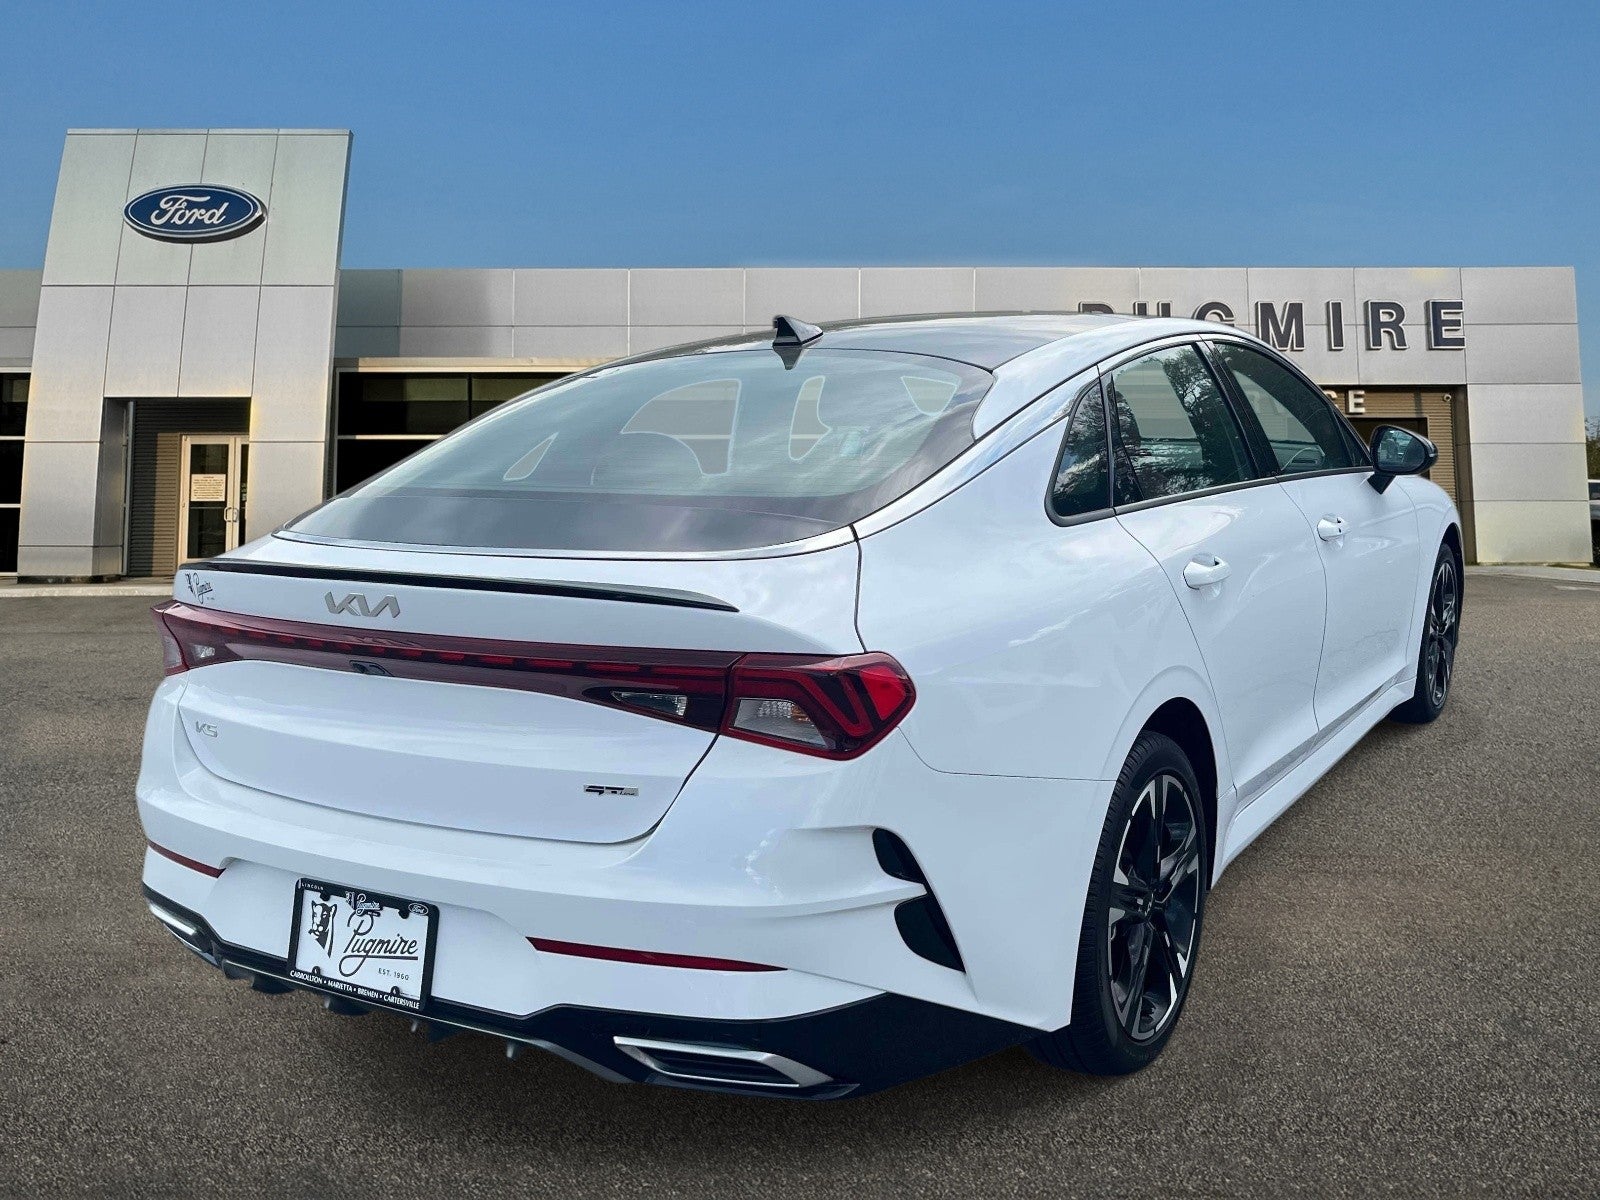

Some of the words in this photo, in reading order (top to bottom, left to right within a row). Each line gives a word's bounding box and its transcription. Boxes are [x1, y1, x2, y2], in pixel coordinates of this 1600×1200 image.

[150, 195, 230, 225] Ford
[1078, 300, 1466, 350] MIRE
[324, 591, 400, 618] KIA
[301, 882, 324, 891] LINCOLN
[338, 911, 419, 978] Pugmire
[378, 967, 392, 977] EST.
[394, 971, 410, 981] 1960
[289, 969, 324, 985] CARROLLTON
[327, 979, 354, 993] MARIETTA
[357, 987, 380, 999] BREMEN
[383, 994, 421, 1010] CARTERSVILLE
